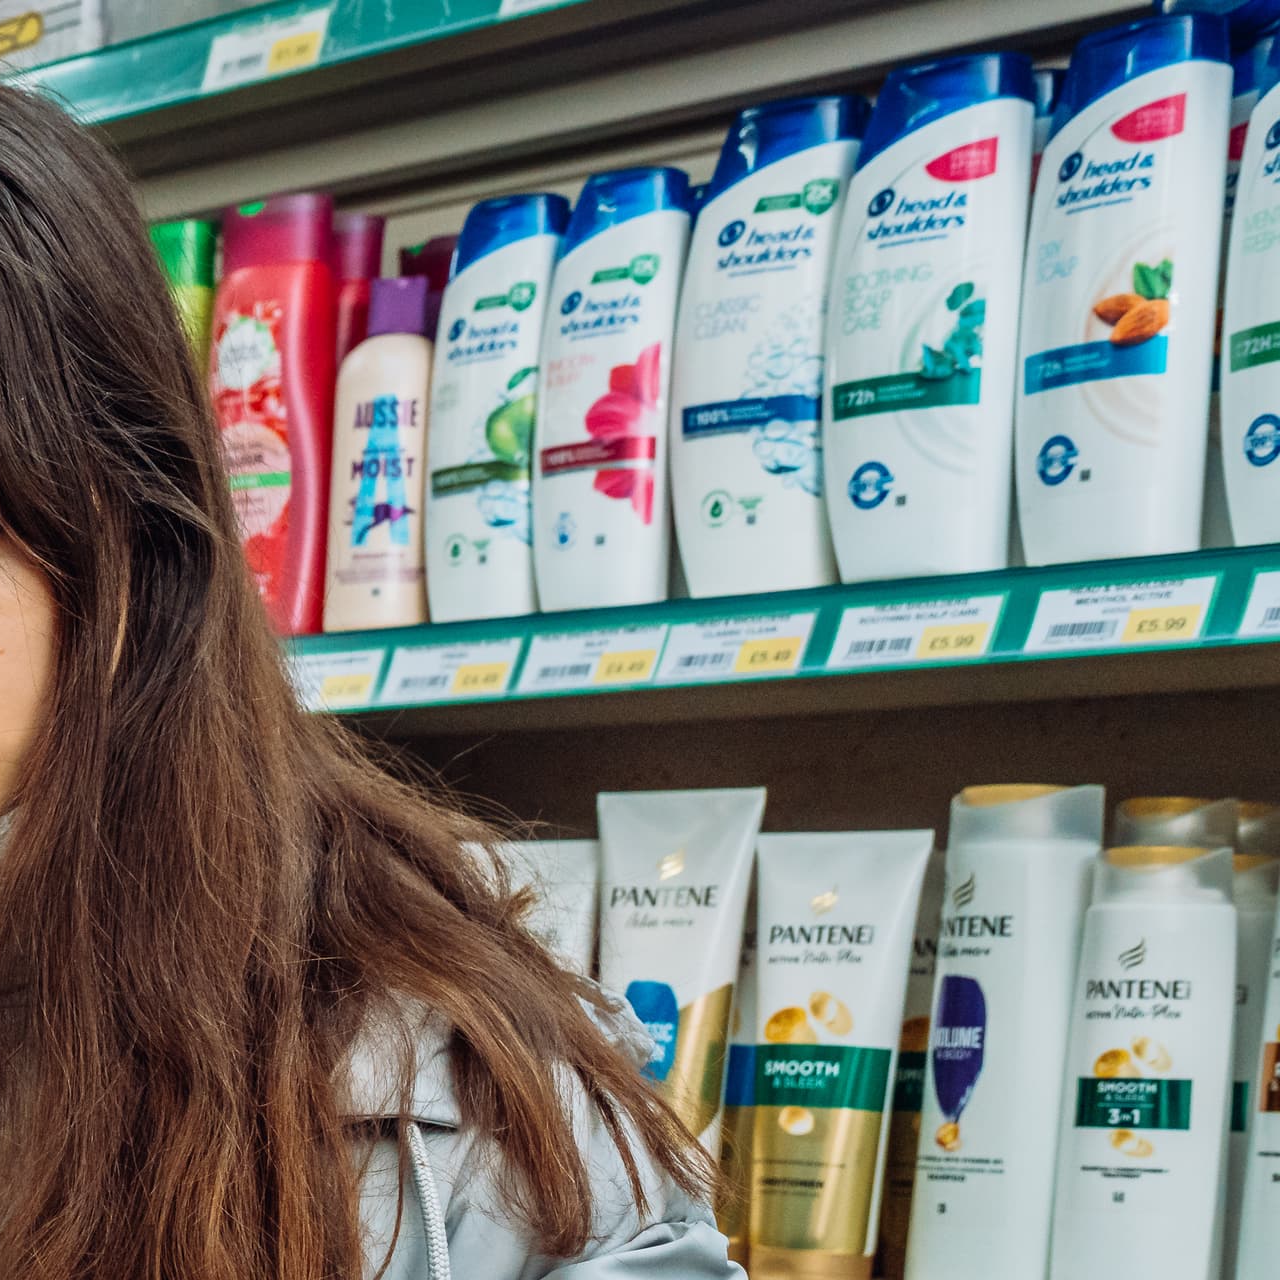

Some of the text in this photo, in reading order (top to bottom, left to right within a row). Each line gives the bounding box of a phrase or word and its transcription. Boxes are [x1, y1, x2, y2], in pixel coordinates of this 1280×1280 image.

[1056, 175, 1151, 207] shoulders
[867, 214, 965, 240] shoulders
[716, 247, 812, 269] shoulders
[354, 399, 419, 428] AUSSIE
[351, 457, 415, 480] MOIST
[1136, 617, 1186, 633] £5.99
[929, 634, 975, 650] £5.99
[610, 884, 719, 908] PANTENE
[768, 925, 868, 946] PANTENE
[942, 915, 1012, 937] NTENE
[1086, 979, 1186, 1000] PANTENE
[764, 1060, 840, 1077] SMOOTH
[1097, 1082, 1157, 1094] SMOOTH
